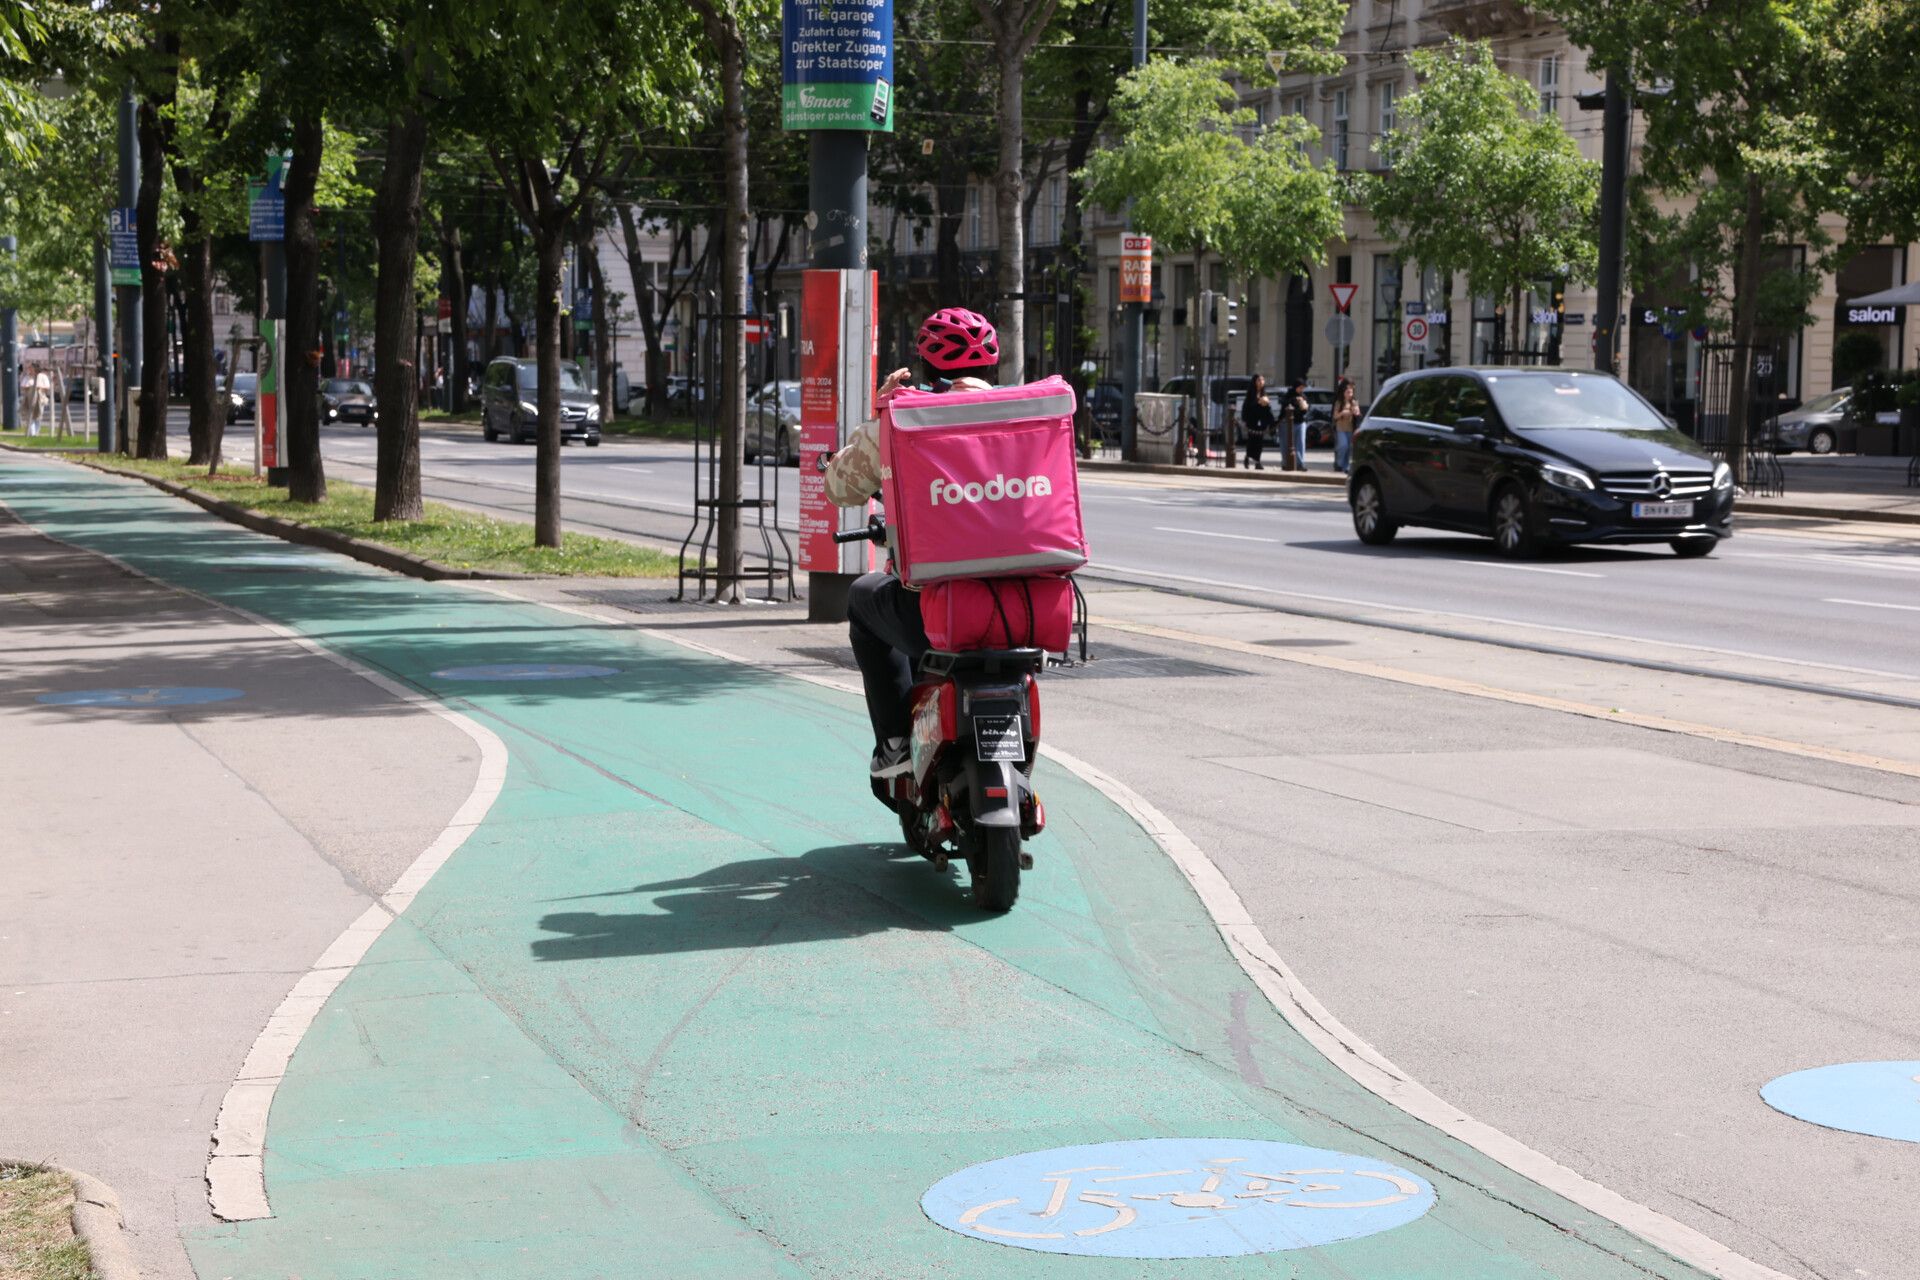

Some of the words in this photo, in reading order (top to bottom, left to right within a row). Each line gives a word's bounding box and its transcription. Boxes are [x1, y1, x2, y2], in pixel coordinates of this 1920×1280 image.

[799, 27, 834, 37] Zufahrt
[837, 27, 859, 37] über
[862, 27, 881, 40] Ring
[792, 41, 841, 53] Direkter
[845, 41, 886, 57] Zugang
[796, 59, 814, 69] zur
[818, 56, 883, 72] Staatsoper
[786, 112, 825, 123] günstiger
[828, 111, 866, 122] parken!
[1126, 240, 1148, 249] ORF
[1848, 306, 1896, 323] saloni
[1412, 323, 1423, 336] 30
[930, 474, 1052, 505] foodora
